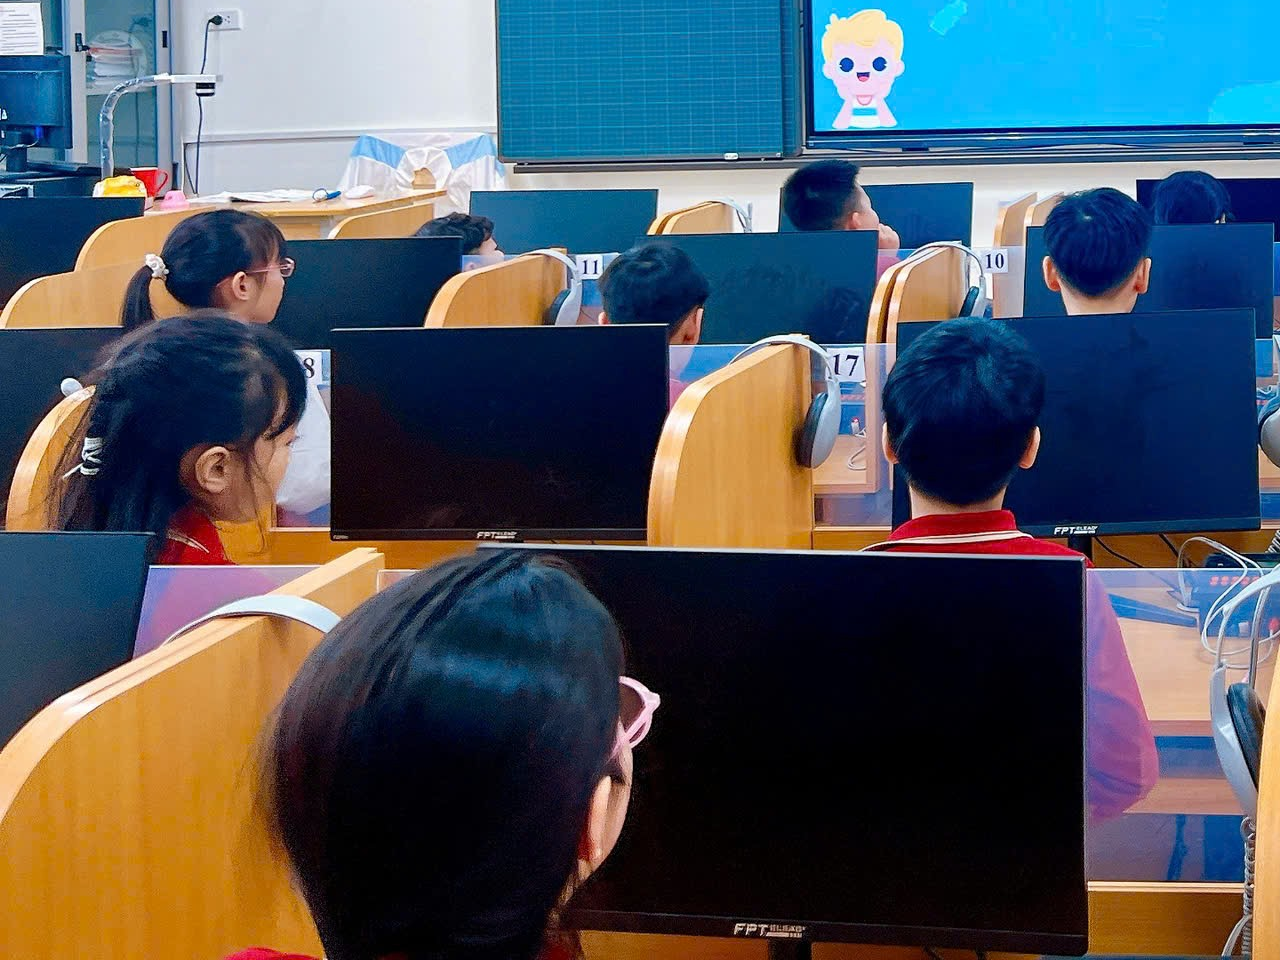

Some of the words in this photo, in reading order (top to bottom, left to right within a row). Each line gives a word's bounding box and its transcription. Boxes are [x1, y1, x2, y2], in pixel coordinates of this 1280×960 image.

[582, 260, 598, 275] 11
[986, 252, 1004, 269] 10
[833, 353, 860, 376] 17
[1053, 526, 1076, 535] FPT
[733, 922, 769, 936] FPT
